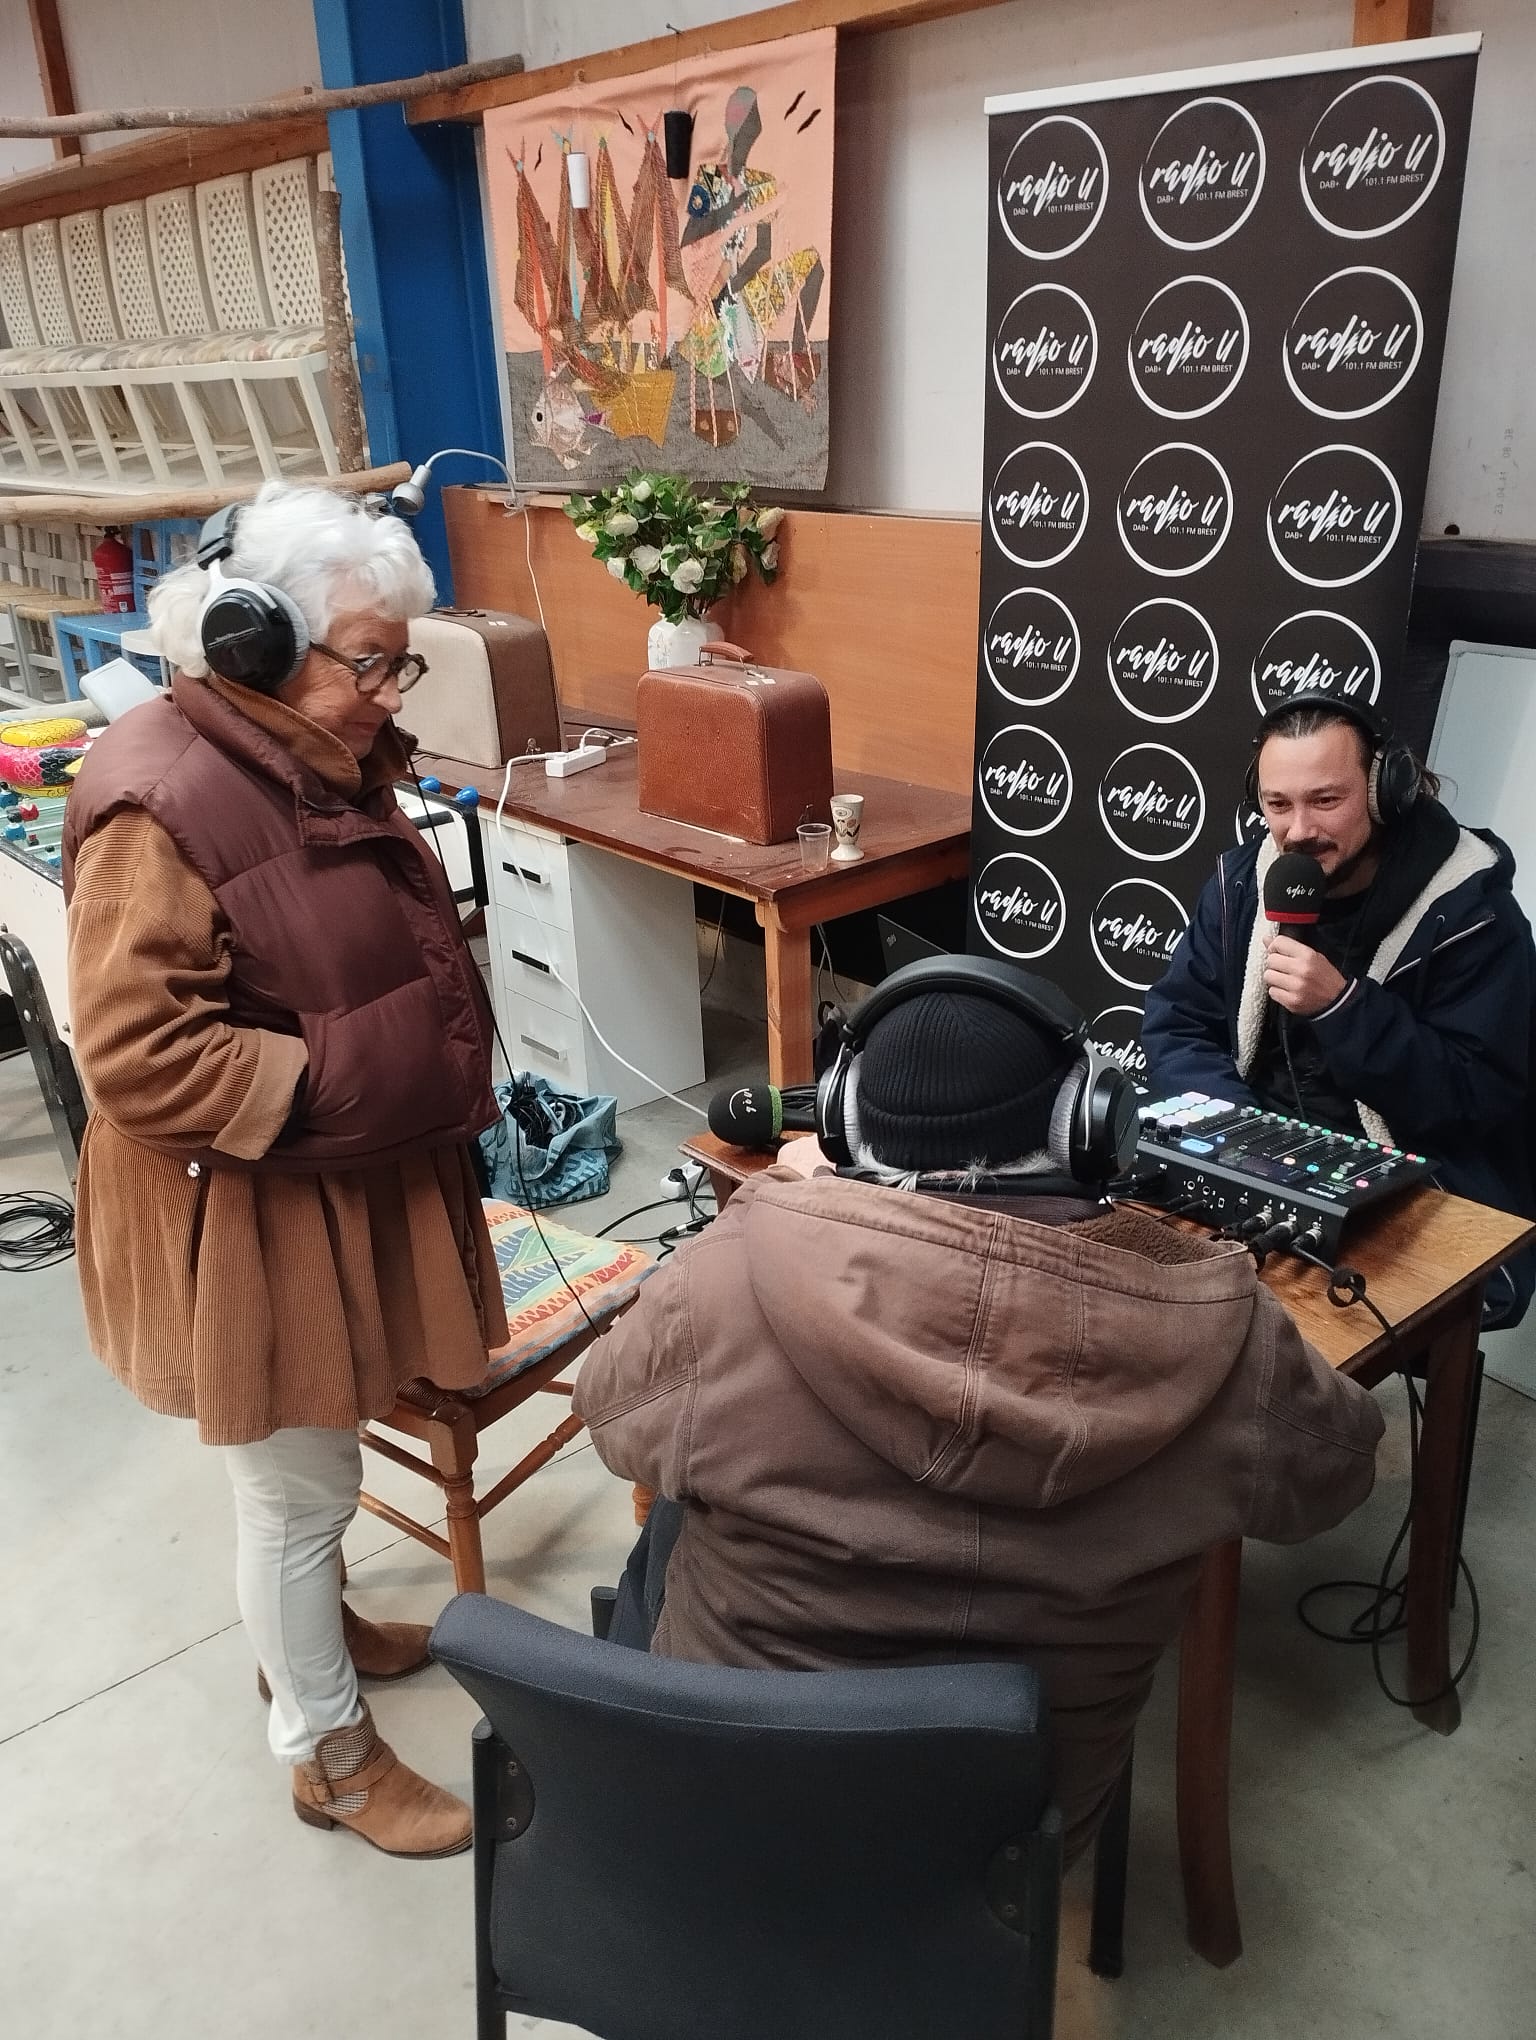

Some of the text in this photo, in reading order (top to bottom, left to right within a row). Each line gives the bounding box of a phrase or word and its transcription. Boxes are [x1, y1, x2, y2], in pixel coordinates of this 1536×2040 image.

[1150, 146, 1255, 204] radio U
[1312, 127, 1432, 190] radio U
[1007, 161, 1099, 216] radio U
[1156, 188, 1248, 204] DAB+ 101.1 FM BREST
[1320, 173, 1424, 190] DAB+ 101.1 FM BREST
[1013, 202, 1094, 216] DAB+ 101.1 FM BREST
[1000, 326, 1088, 377] radio U
[1138, 321, 1239, 375] radio U
[1294, 315, 1411, 372] radio U
[1006, 367, 1083, 376] DAB+ 101.1 FM BREST
[1144, 365, 1162, 374] DAB+
[1182, 365, 1198, 373] 101.1
[1212, 364, 1233, 373] BREST
[1301, 362, 1320, 370] DAB+
[1345, 362, 1364, 370] 101.1
[1378, 361, 1402, 370] BREST
[996, 482, 1080, 528] radio U
[1001, 518, 1015, 526] DAB+
[1032, 520, 1046, 528] 101.1
[1126, 485, 1223, 534] radio U
[1278, 490, 1390, 542] radio U
[1132, 524, 1149, 532] DAB+
[1169, 526, 1184, 534] 101.1
[1197, 528, 1217, 536] BREST
[1284, 531, 1381, 544] DAB+ 101.1 FM BREST
[991, 625, 1072, 668] radio U
[996, 656, 1009, 664] DAB+
[1040, 662, 1050, 670] FM
[1050, 664, 1068, 672] BREST
[1117, 638, 1209, 682] radio U
[1262, 653, 1369, 696] radio U
[985, 760, 1064, 799] radio U
[1107, 780, 1196, 821] radio U
[980, 886, 1058, 924] radio U
[1098, 914, 1184, 954] radio U
[1161, 953, 1172, 962] BRE
